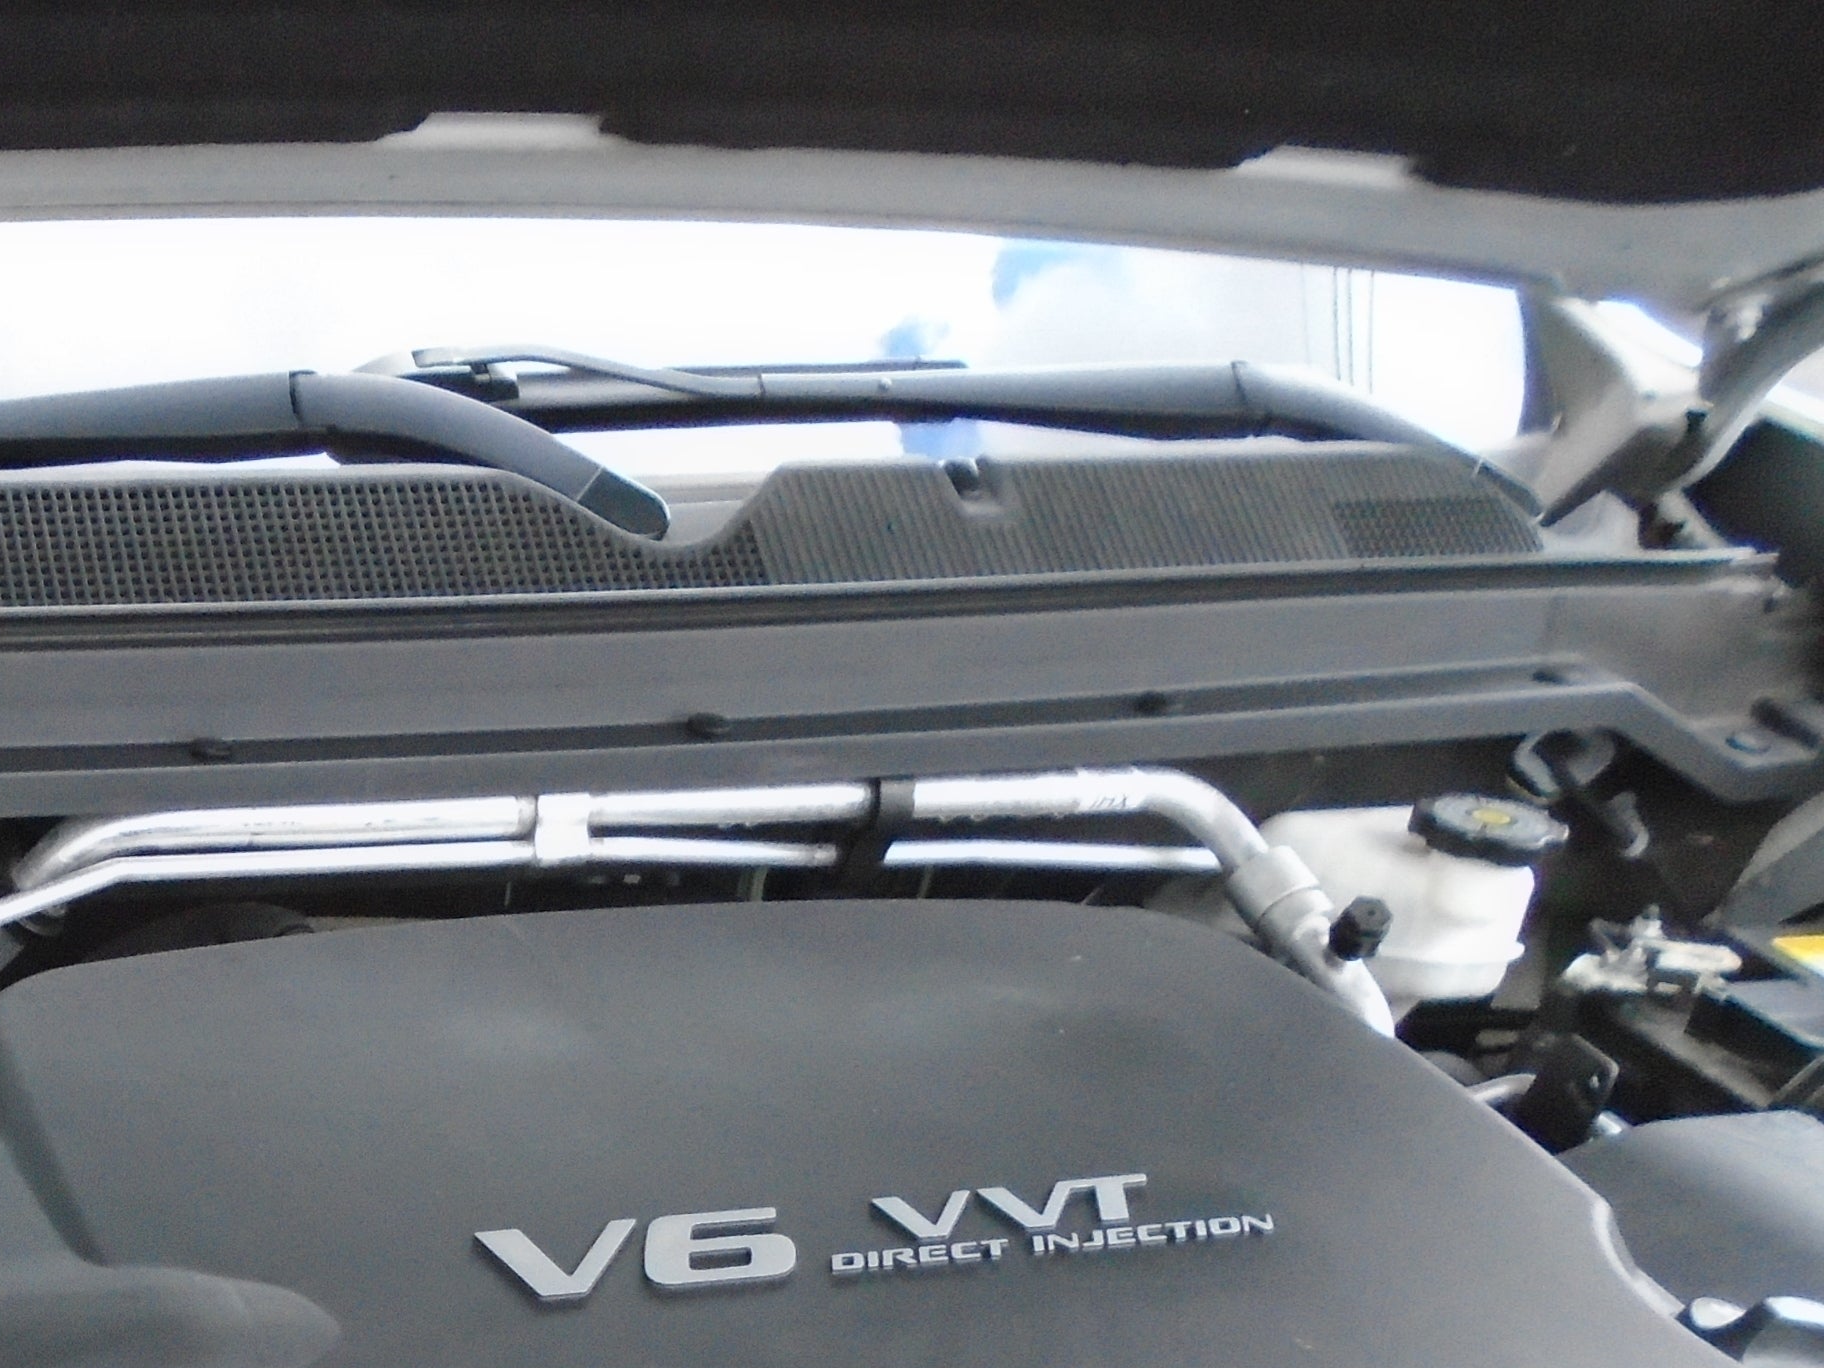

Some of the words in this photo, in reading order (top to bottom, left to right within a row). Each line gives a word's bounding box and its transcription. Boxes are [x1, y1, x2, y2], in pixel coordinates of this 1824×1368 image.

[473, 1206, 797, 1298] V6
[871, 1173, 1147, 1240] VVT
[830, 1239, 1009, 1274] DIRECT
[1032, 1213, 1275, 1254] INJECTION
